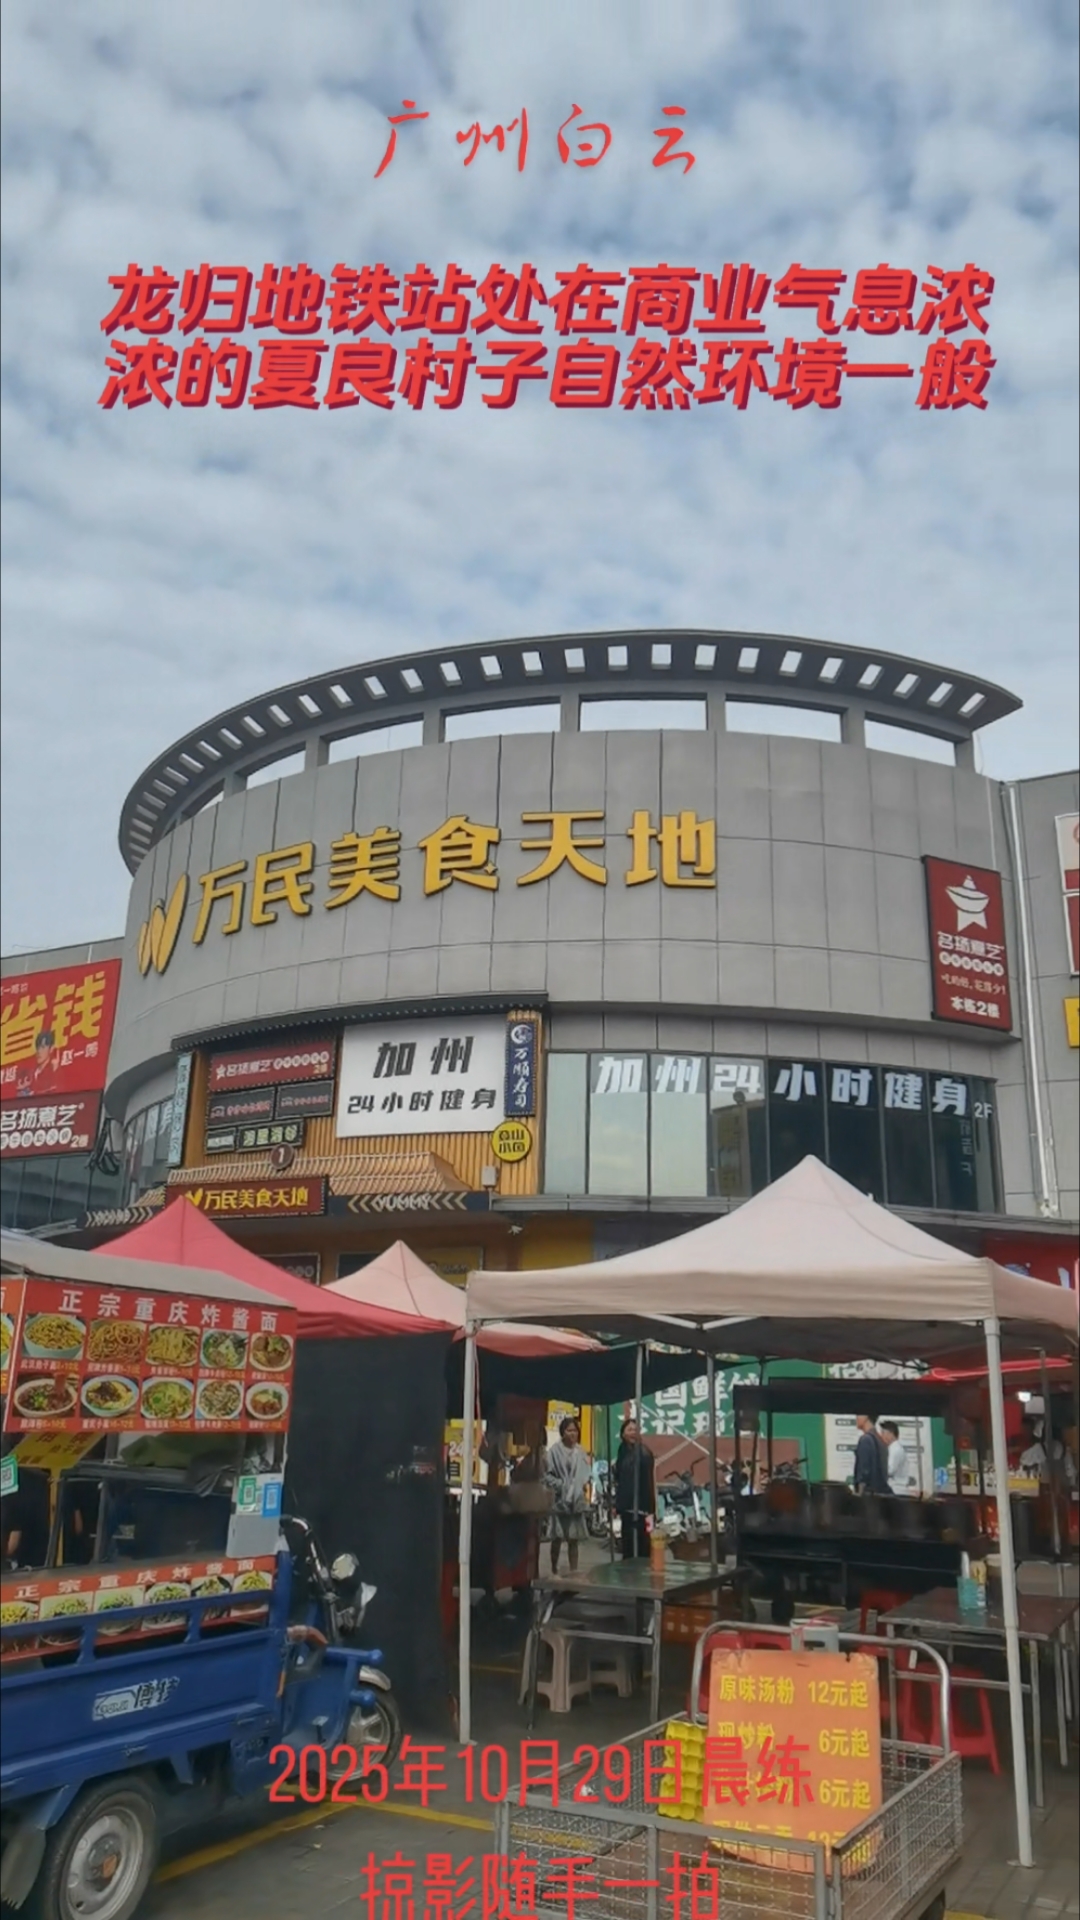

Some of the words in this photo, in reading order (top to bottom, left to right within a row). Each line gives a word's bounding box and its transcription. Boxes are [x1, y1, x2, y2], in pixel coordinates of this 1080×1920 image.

[191, 811, 716, 945] 万民美食天地
[373, 1036, 474, 1079] 加州
[347, 1088, 497, 1114] 24小时健身
[597, 1056, 967, 1116] 加州24小时健身
[974, 1102, 993, 1118] 2F
[204, 1187, 308, 1210] 万民美食天地
[58, 1289, 278, 1333] 正宗重庆炸酱面
[15, 1558, 256, 1599] 正宗重庆炸酱面
[719, 1674, 795, 1705] 原味汤粉
[807, 1680, 869, 1708] 12元起
[819, 1728, 870, 1758] 6元起
[819, 1778, 871, 1810] 6元起
